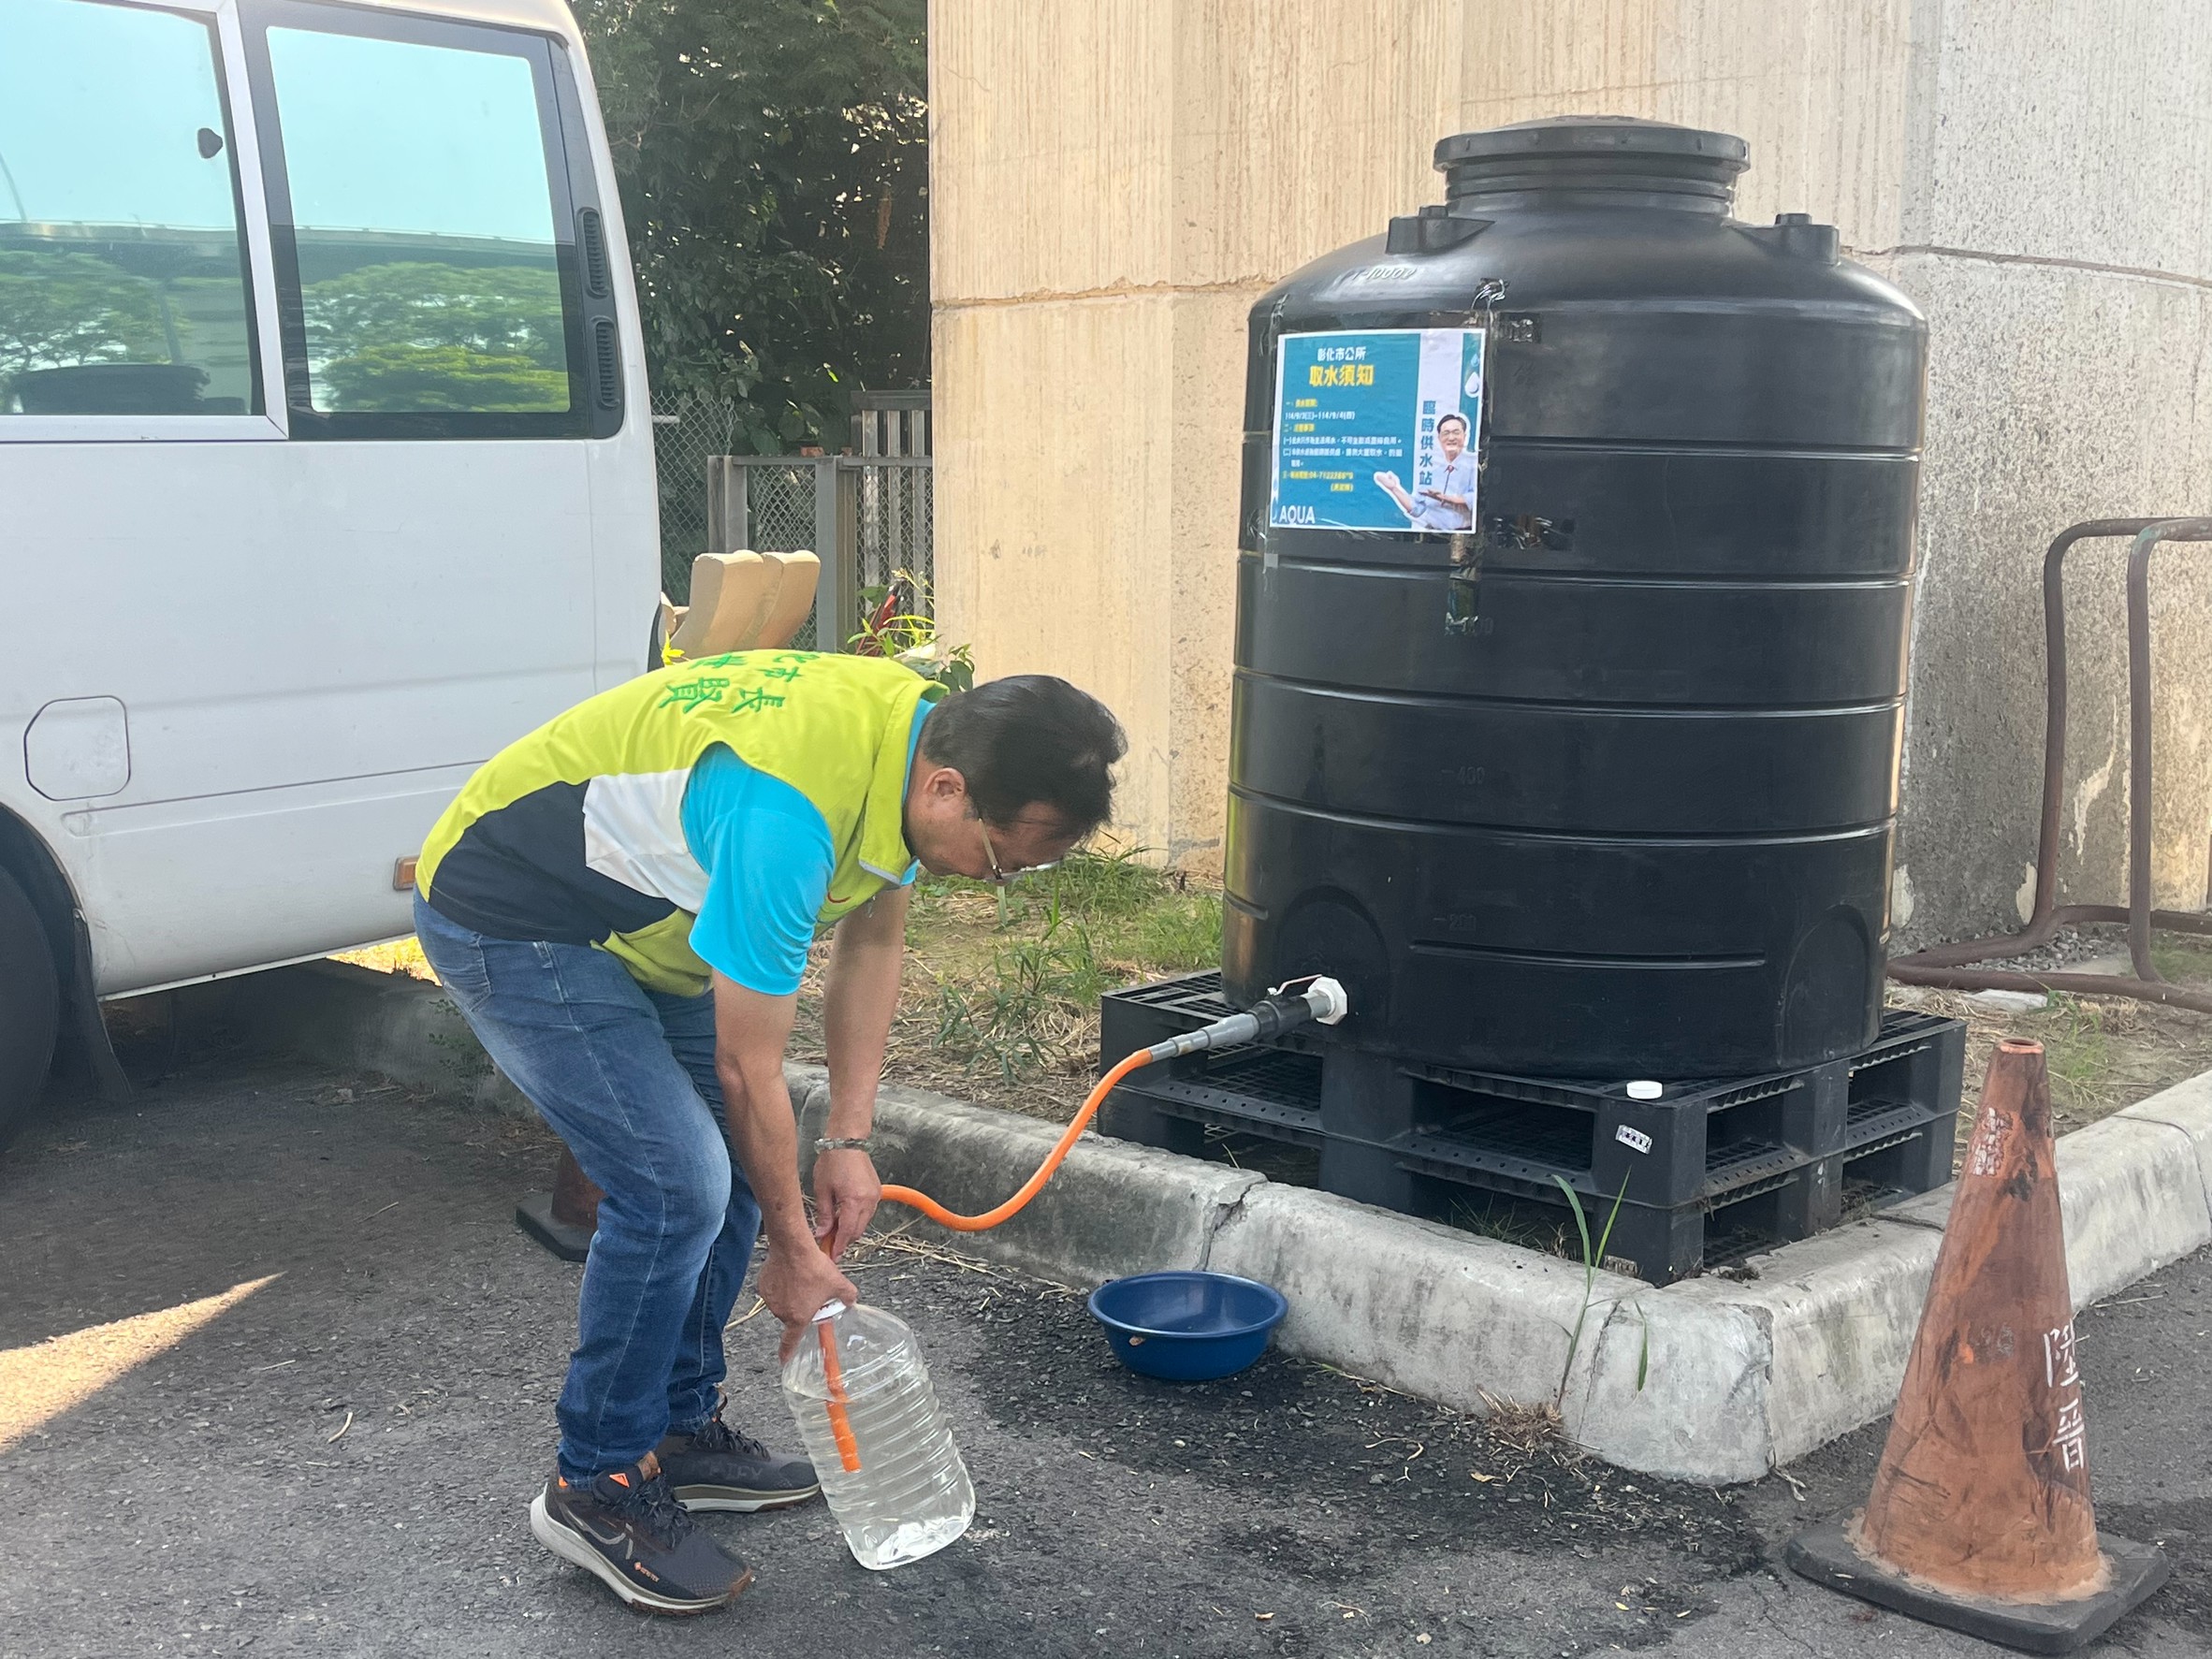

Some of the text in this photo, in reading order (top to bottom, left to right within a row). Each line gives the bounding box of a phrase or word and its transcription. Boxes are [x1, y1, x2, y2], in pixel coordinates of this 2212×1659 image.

[1317, 346, 1367, 362] 彰化市公所
[1309, 364, 1375, 387] 取水須知
[1419, 400, 1436, 486] 臨時供水站
[1279, 505, 1316, 524] AQUA
